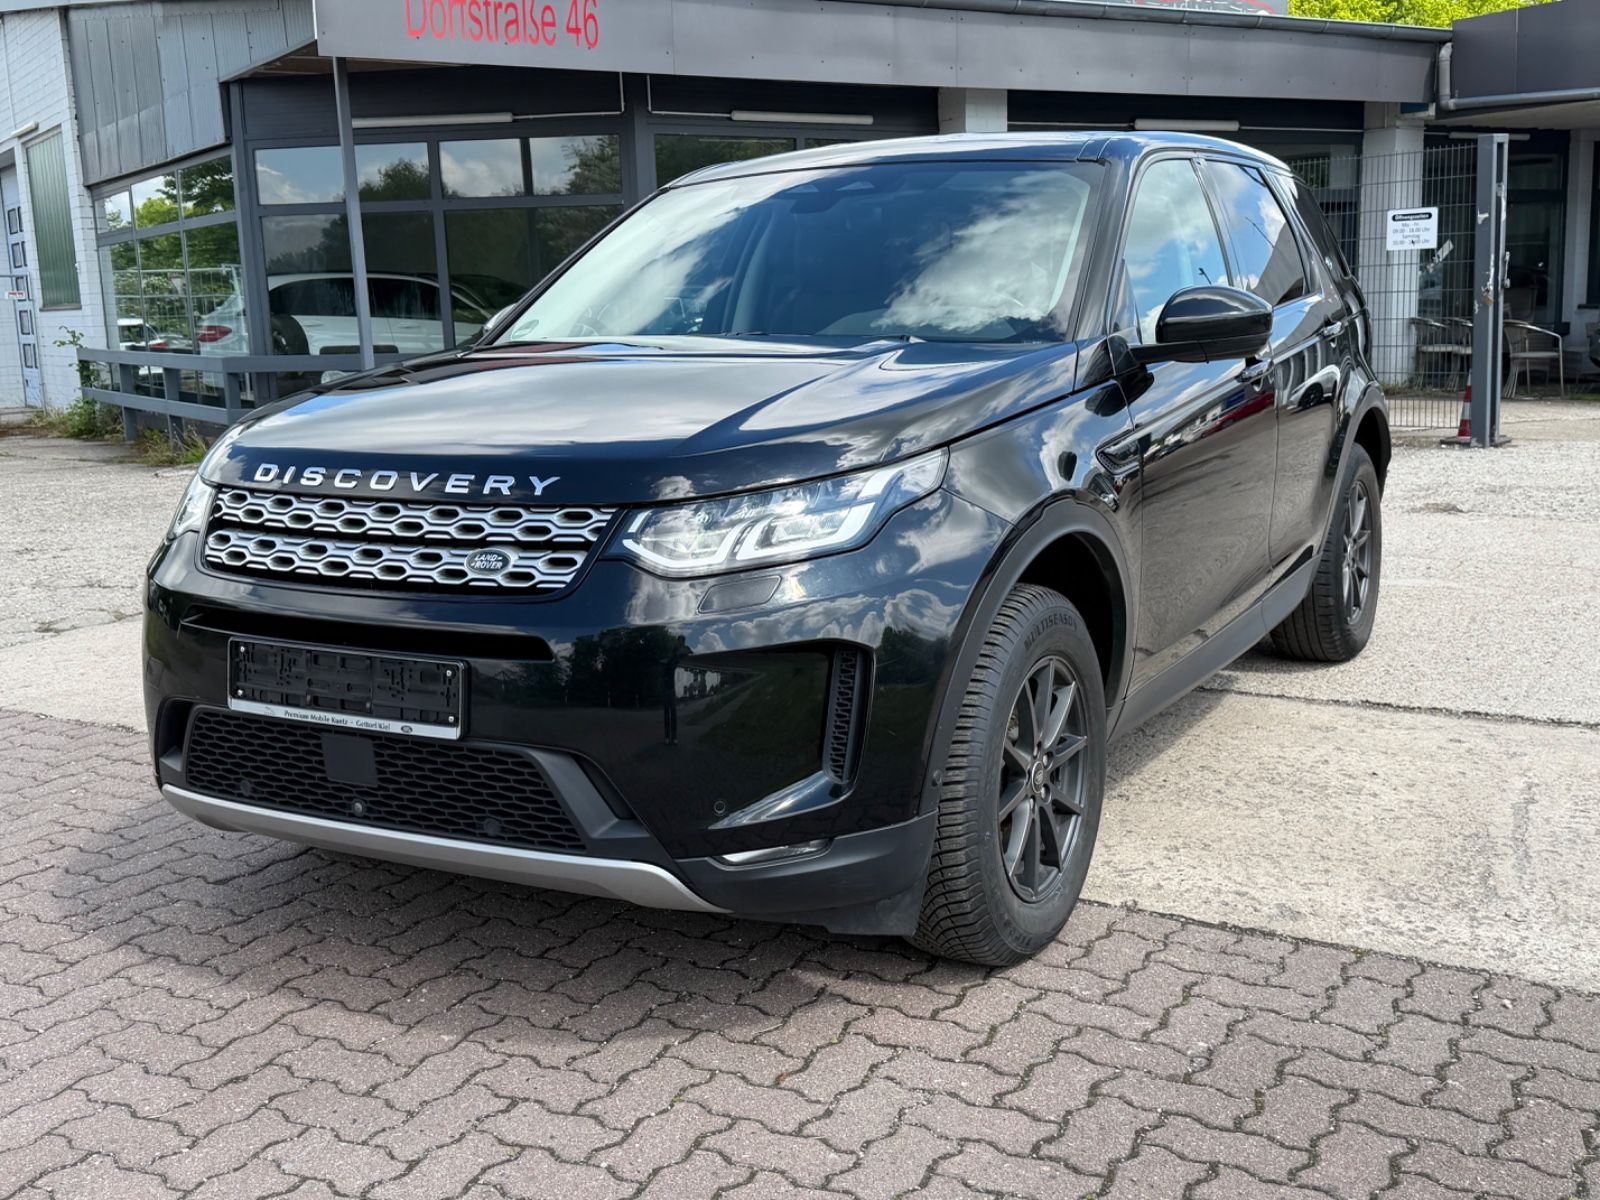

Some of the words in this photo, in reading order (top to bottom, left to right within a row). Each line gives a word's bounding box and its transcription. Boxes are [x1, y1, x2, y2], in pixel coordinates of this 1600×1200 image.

[405, 0, 557, 46] Dorfstraße
[566, 0, 599, 49] 46
[254, 462, 561, 496] DISCOVERY
[284, 710, 309, 719] Premium
[310, 714, 330, 722] Mobile
